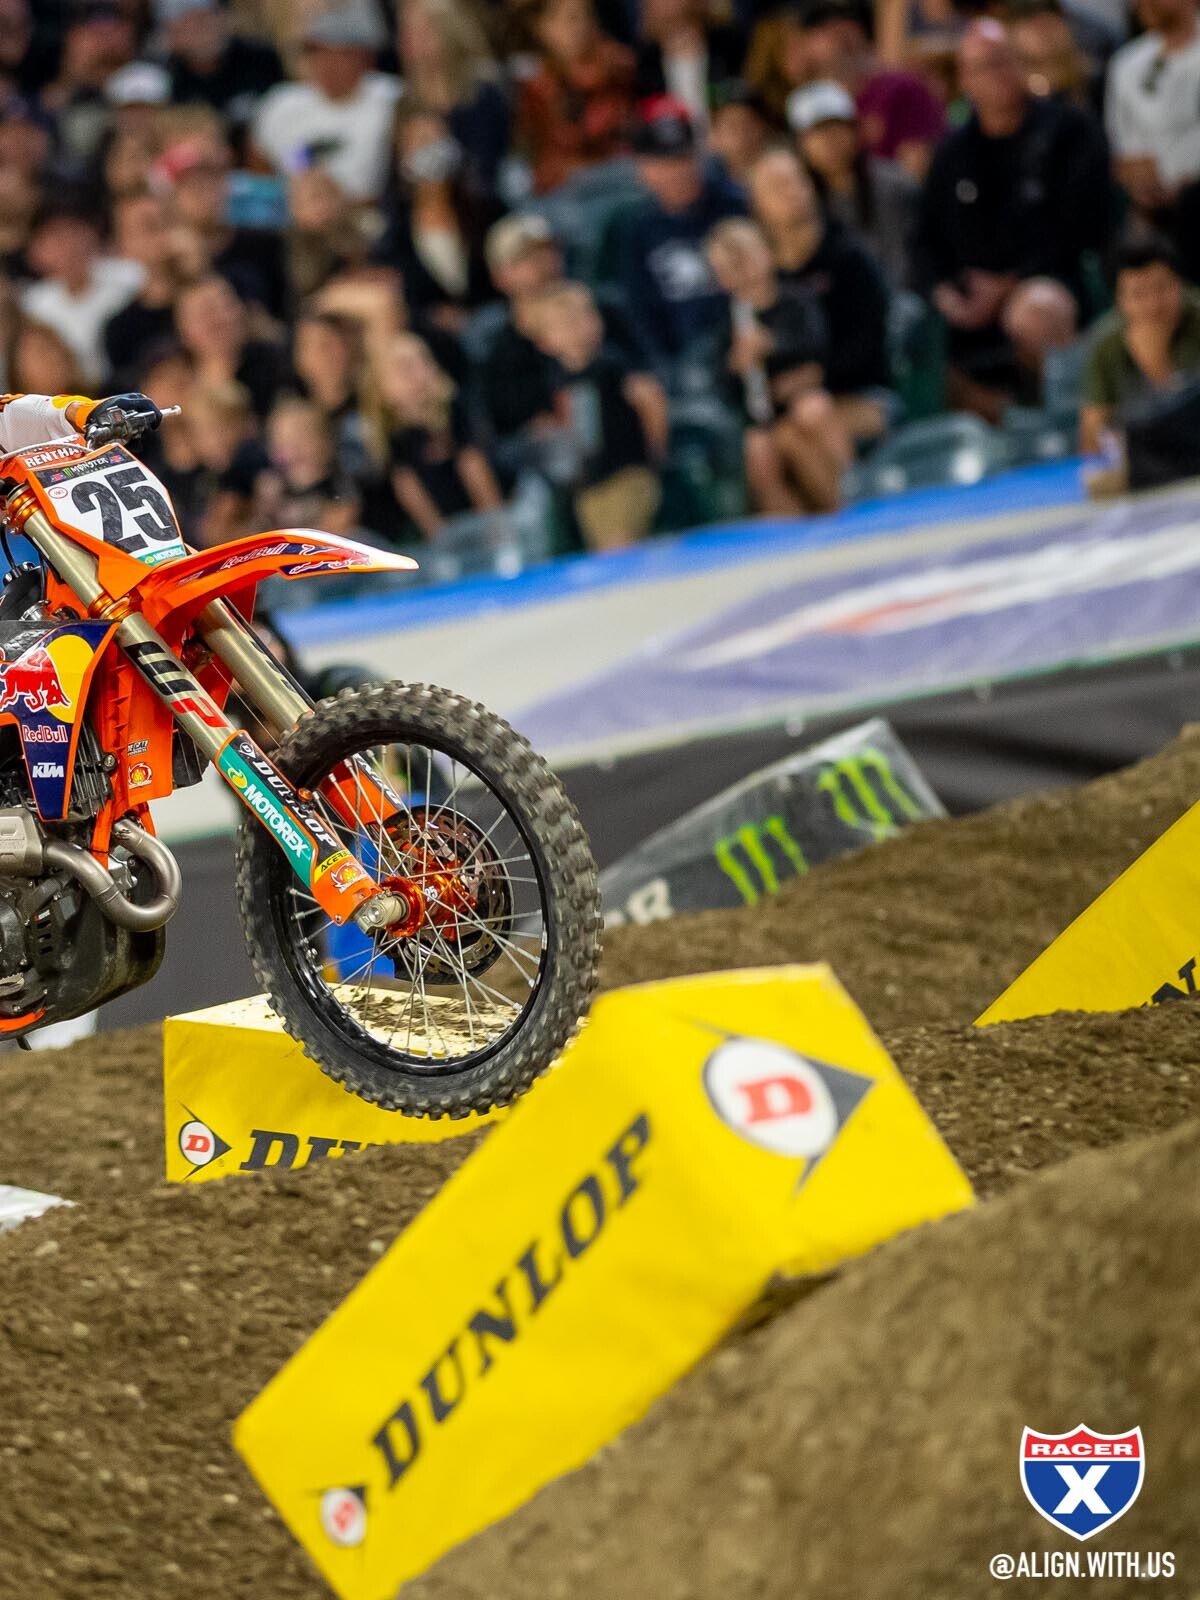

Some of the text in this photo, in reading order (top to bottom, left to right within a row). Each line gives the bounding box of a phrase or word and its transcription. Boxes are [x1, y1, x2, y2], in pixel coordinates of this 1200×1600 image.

[71, 466, 181, 554] 25
[32, 762, 64, 778] KTM
[244, 782, 311, 858] MOTOREX
[369, 1111, 654, 1492] DUNLOP
